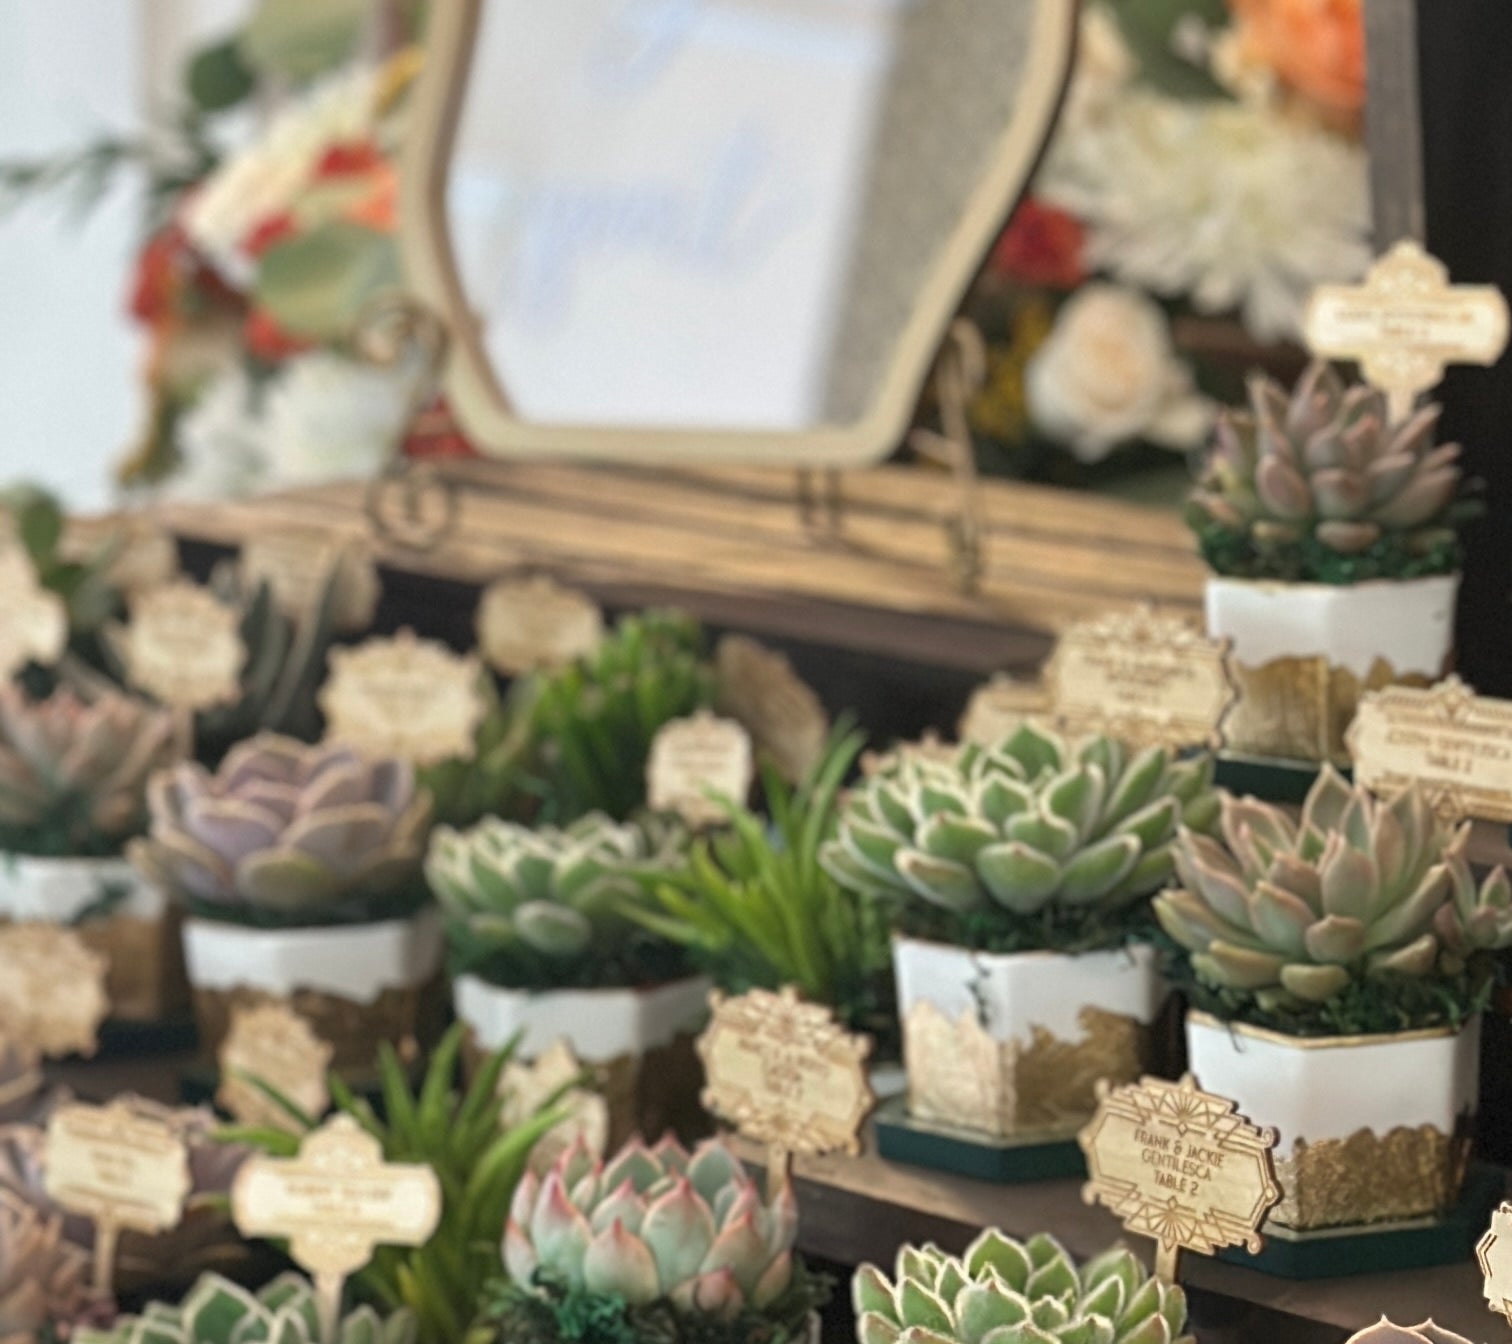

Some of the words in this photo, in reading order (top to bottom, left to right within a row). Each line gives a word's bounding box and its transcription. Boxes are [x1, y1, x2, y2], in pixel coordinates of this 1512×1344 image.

[1134, 1128, 1170, 1151] FRANK
[1186, 1143, 1225, 1169] JACKIE
[1141, 1148, 1212, 1182] GENTILESCA
[1154, 1168, 1186, 1193] TABLE
[1190, 1180, 1200, 1197] 2
